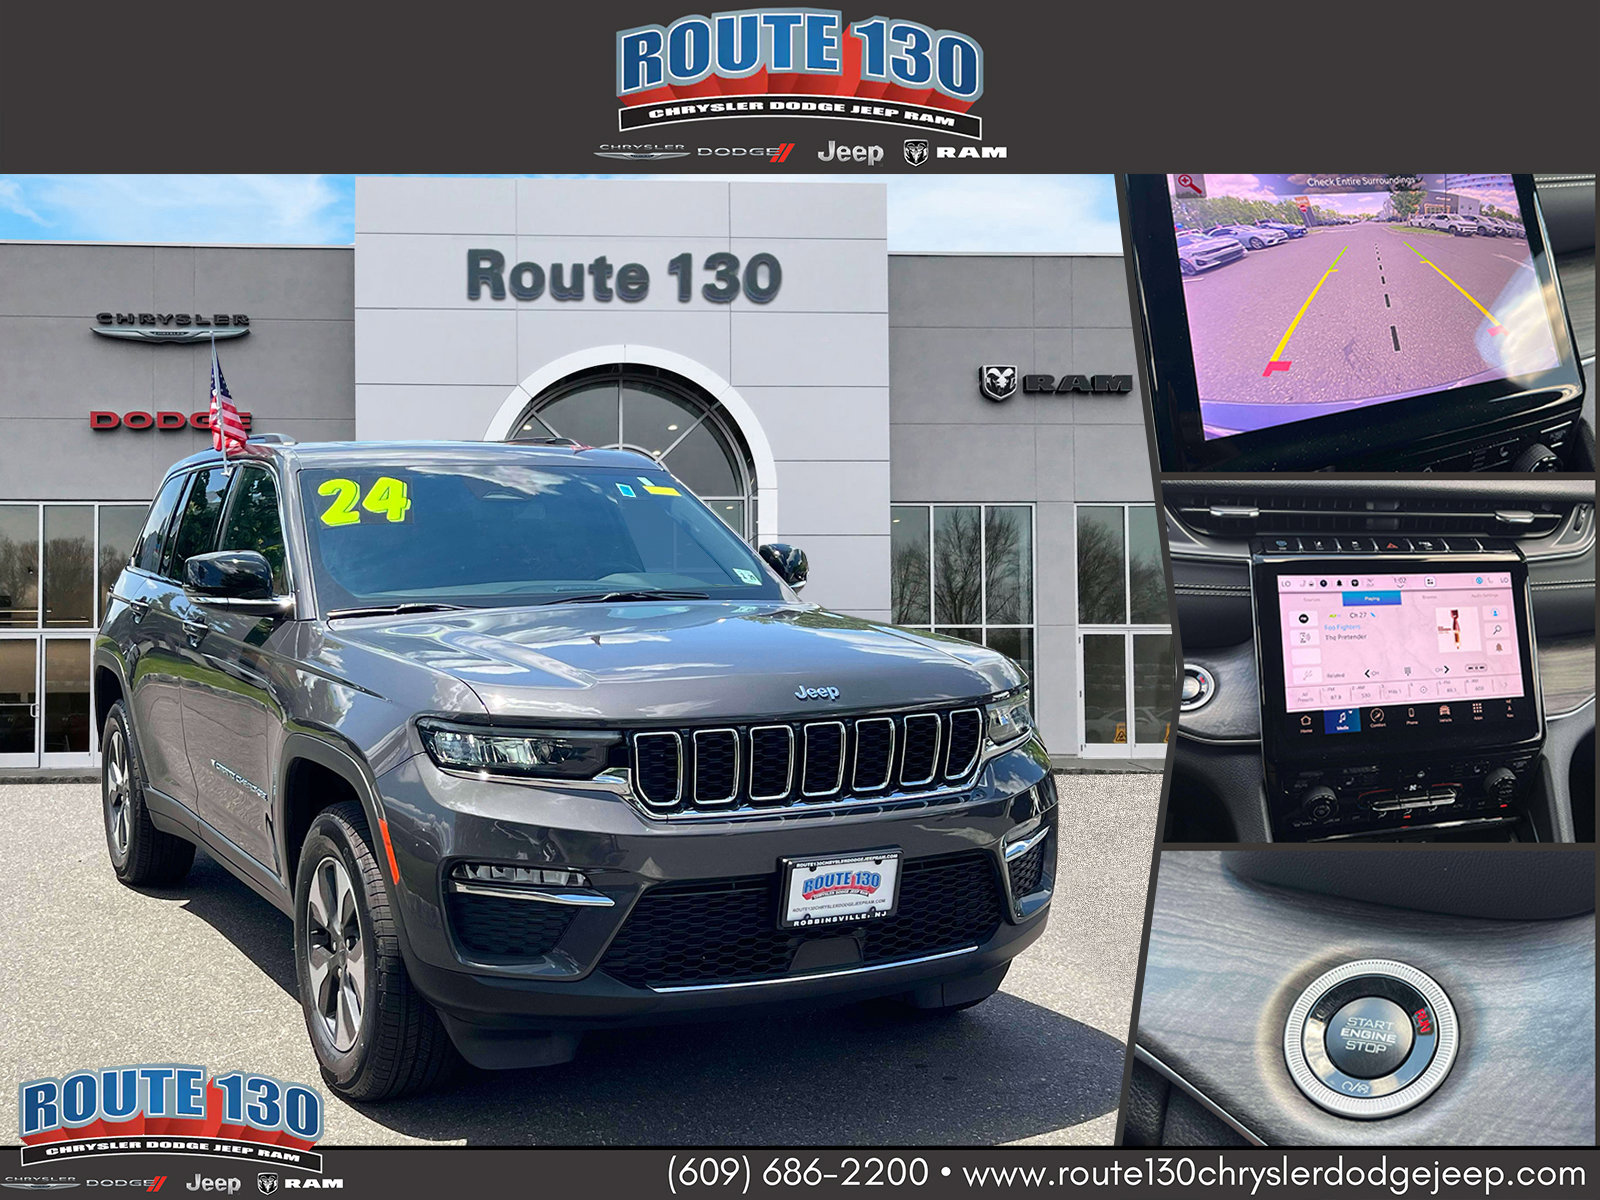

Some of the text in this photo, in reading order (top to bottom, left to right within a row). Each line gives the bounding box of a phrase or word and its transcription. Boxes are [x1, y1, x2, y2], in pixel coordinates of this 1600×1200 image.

[1307, 176, 1416, 187] Check Entire Surroundings
[467, 249, 782, 304] Route 130
[96, 312, 250, 326] CHRYSLER
[1023, 374, 1133, 393] RAM
[317, 476, 412, 526] 24
[794, 685, 840, 701] Jeep
[803, 871, 881, 894] ROUTE 130
[793, 912, 871, 927] ROBBINSVILLE,
[1346, 1017, 1395, 1030] START
[1414, 1008, 1431, 1033] RUN
[1340, 1028, 1397, 1043] ENGINE
[1345, 1040, 1387, 1054] STOP
